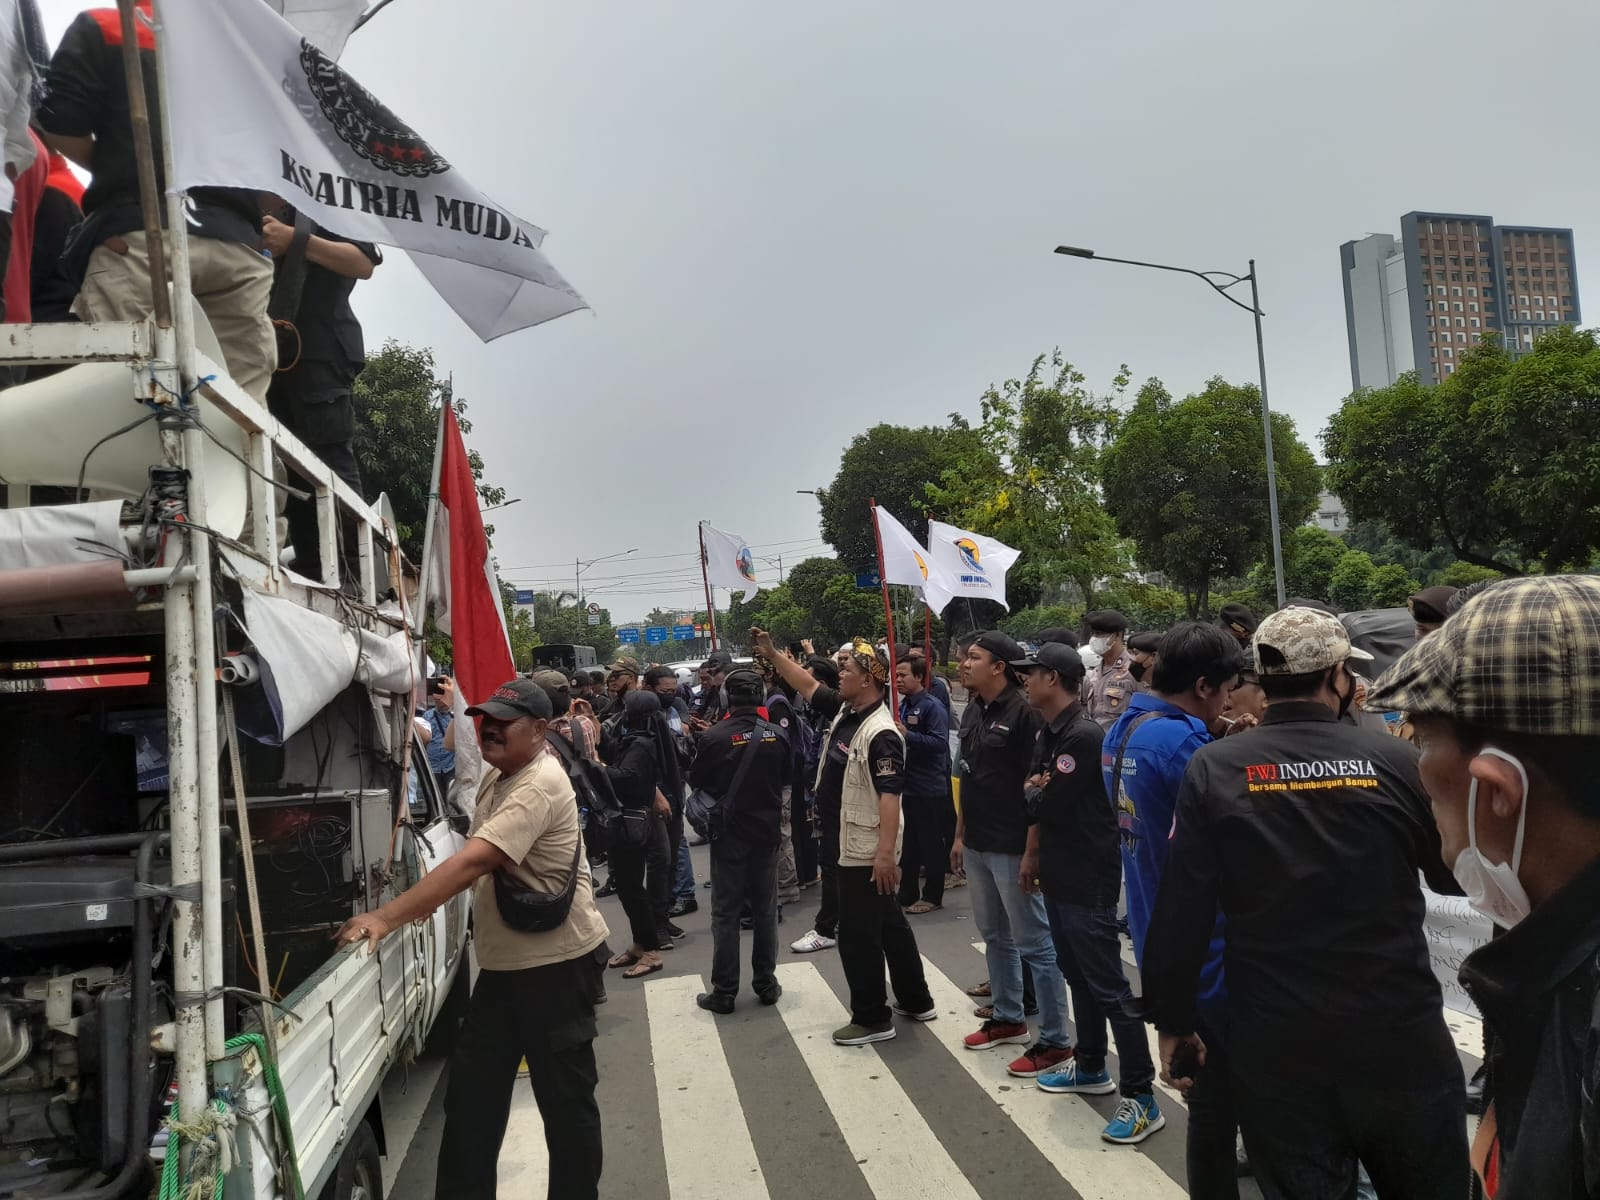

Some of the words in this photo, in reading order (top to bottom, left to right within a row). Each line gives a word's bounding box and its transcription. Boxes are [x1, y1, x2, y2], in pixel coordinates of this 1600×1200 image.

[279, 149, 423, 223] KSATRIA
[434, 194, 536, 250] MUDA
[1245, 763, 1278, 782] FWJ
[1278, 759, 1377, 780] INDONESIA
[1248, 782, 1288, 792] Bersama
[1289, 779, 1343, 791] Membangun
[1345, 777, 1378, 788] Bangsa
